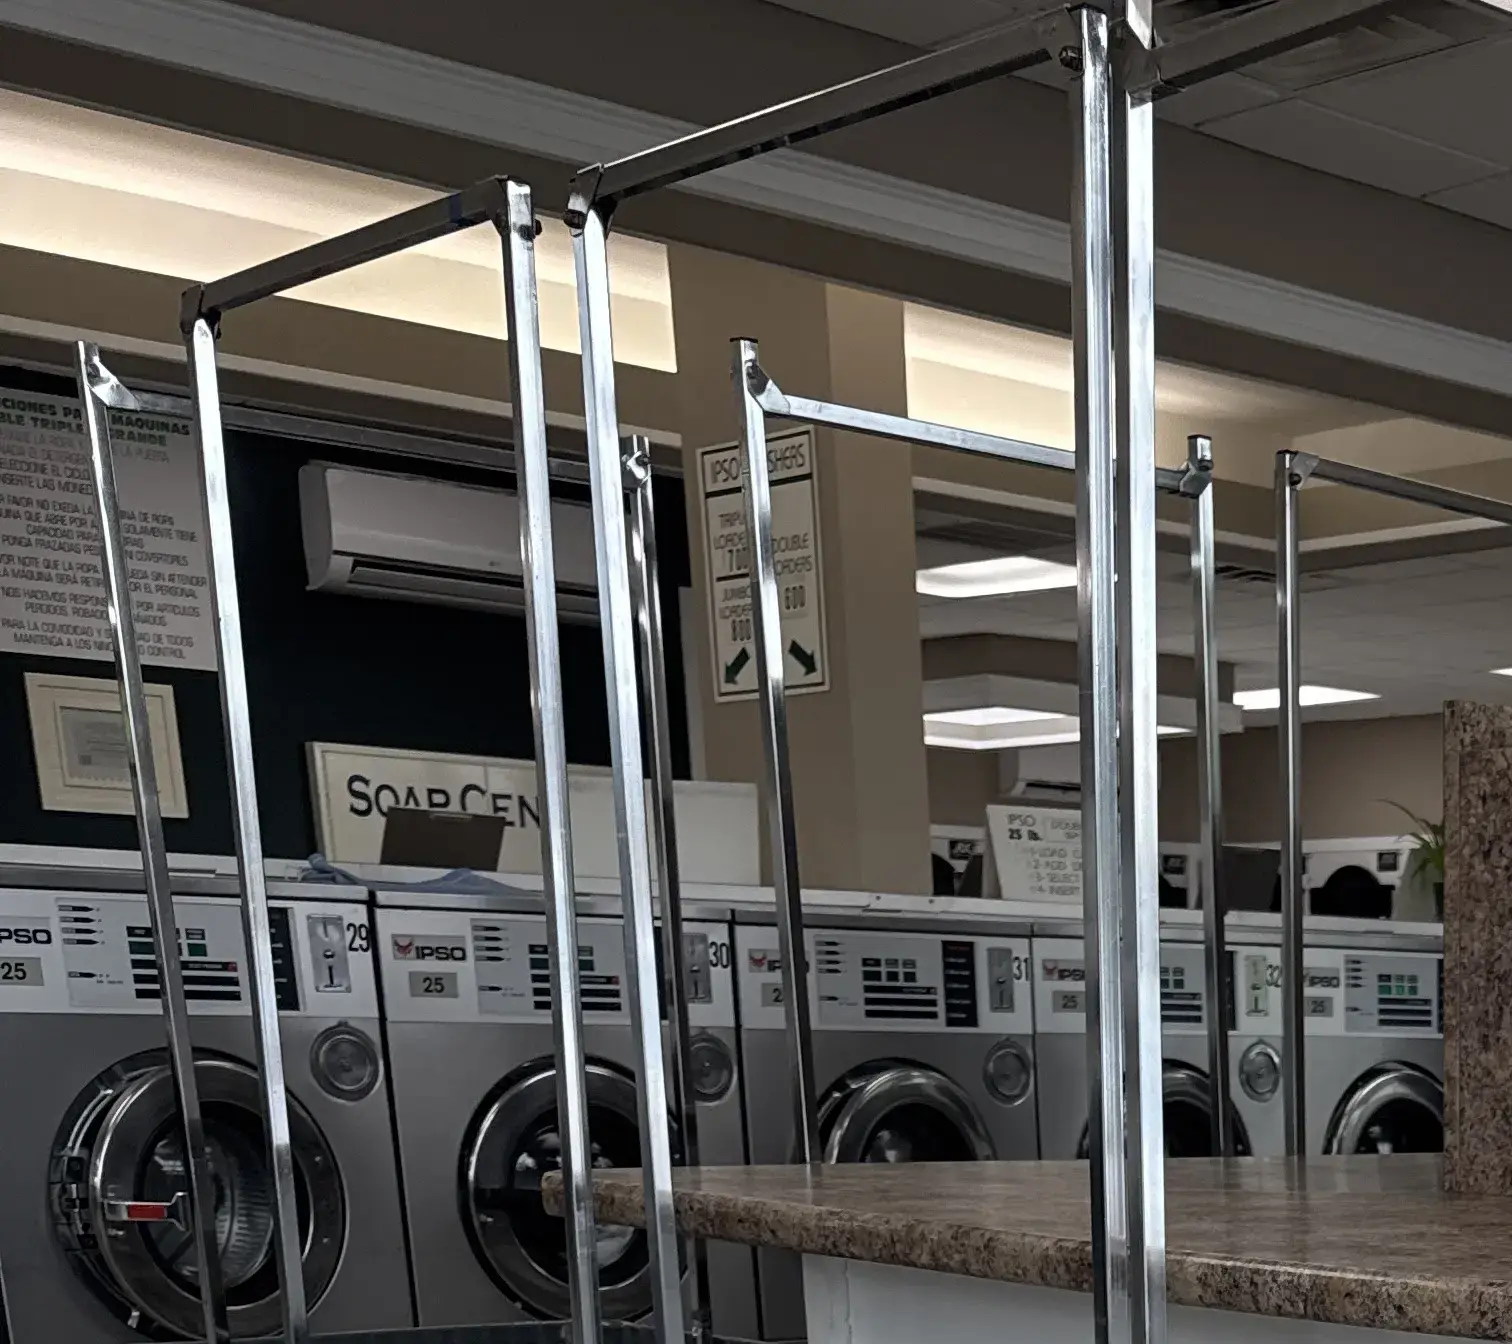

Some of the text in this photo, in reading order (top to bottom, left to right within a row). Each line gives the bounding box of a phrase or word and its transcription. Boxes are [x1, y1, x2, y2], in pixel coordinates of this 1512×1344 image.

[0, 397, 57, 416] CIONES
[111, 412, 190, 436] MAQUINAS
[0, 410, 25, 426] BLE
[30, 416, 84, 434] TRIPLE
[710, 443, 806, 484] IPSO SHERS
[0, 472, 34, 488] NSERTE
[57, 479, 93, 496] MONED
[713, 533, 748, 551] LOADE
[774, 554, 813, 577] OADERS
[460, 783, 541, 829] CEN
[0, 928, 52, 945] PSO
[347, 922, 370, 953] 29
[415, 945, 467, 962] IPSO
[709, 941, 730, 969] 30
[1, 962, 27, 981] 25
[1013, 955, 1030, 982] 31
[1058, 968, 1086, 982] IPS
[422, 977, 446, 994] 25
